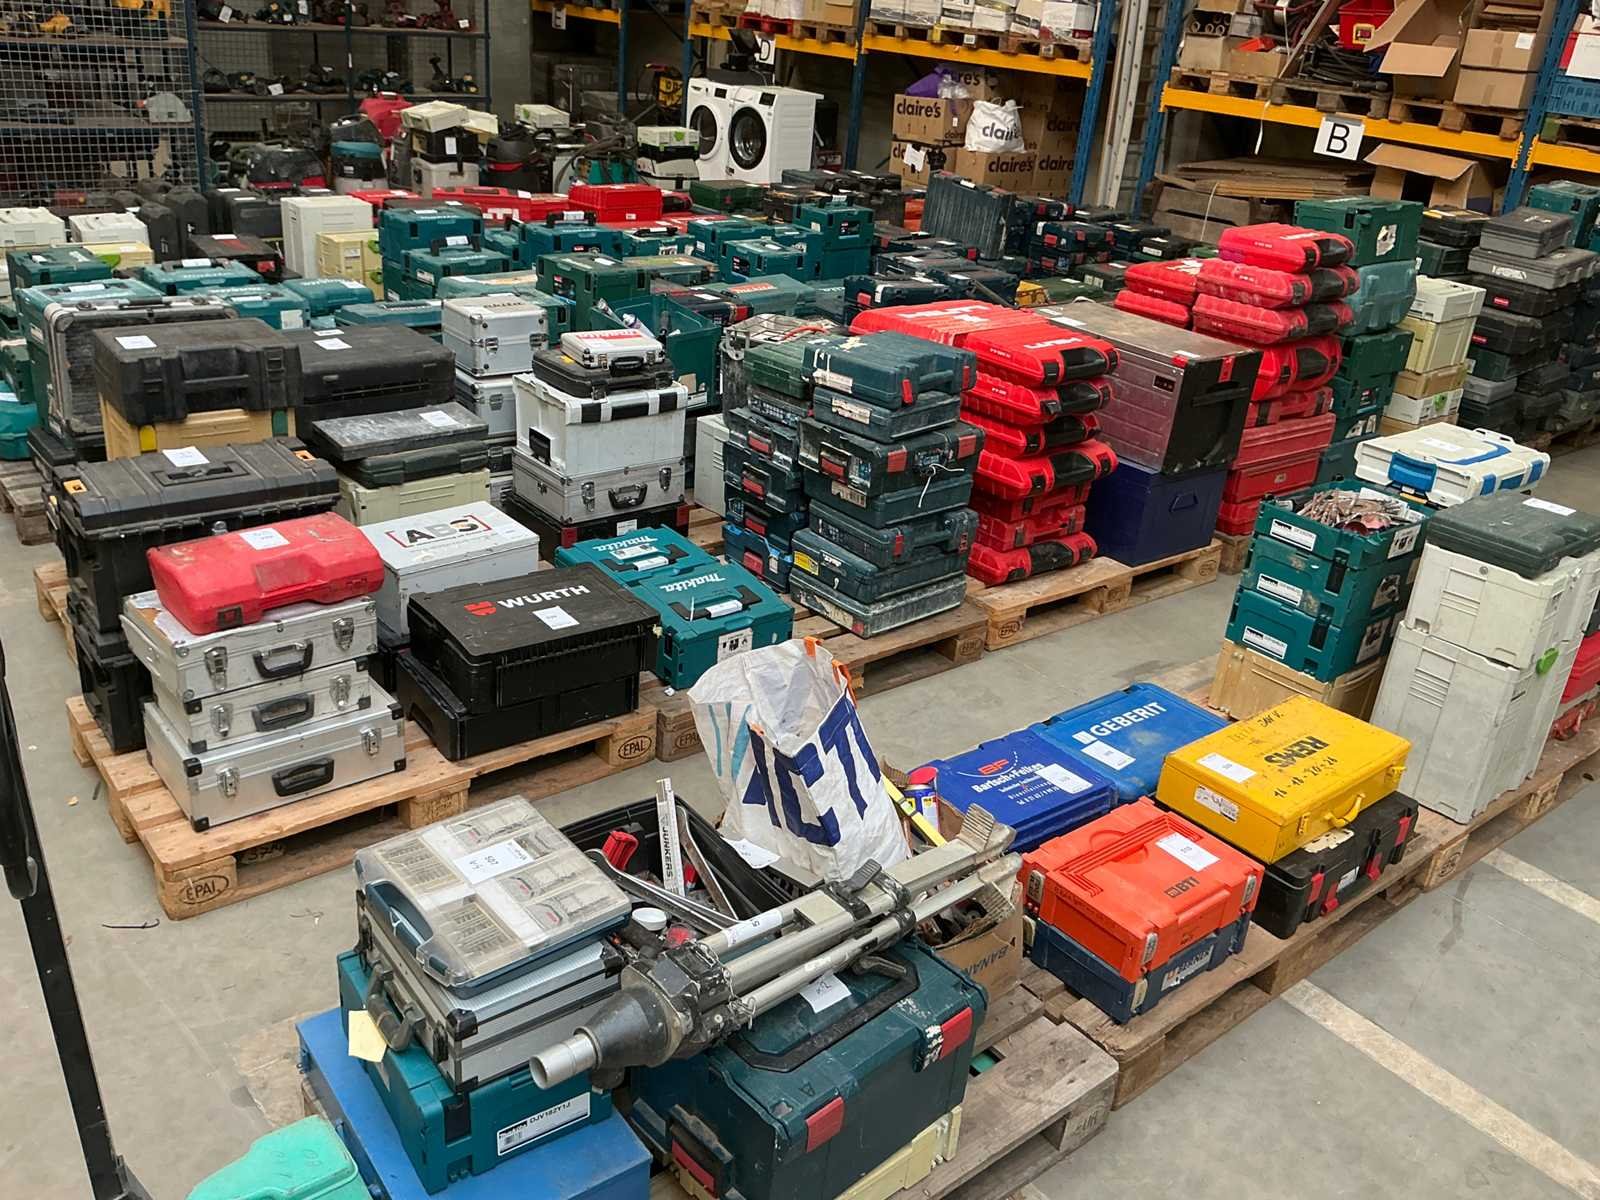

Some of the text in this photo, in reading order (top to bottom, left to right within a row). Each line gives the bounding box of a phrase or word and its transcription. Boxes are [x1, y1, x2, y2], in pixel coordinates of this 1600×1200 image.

[758, 39, 771, 61] D
[896, 99, 942, 118] claire's
[1325, 122, 1351, 154] B
[988, 156, 1034, 174] claire's
[405, 518, 479, 545] ABS
[1089, 701, 1168, 737] GEBERIT
[622, 739, 646, 757] EPAL
[1264, 735, 1330, 769] REMS
[977, 758, 1010, 776] BF
[661, 826, 674, 879] JUNKERS
[1176, 875, 1201, 893] BTI
